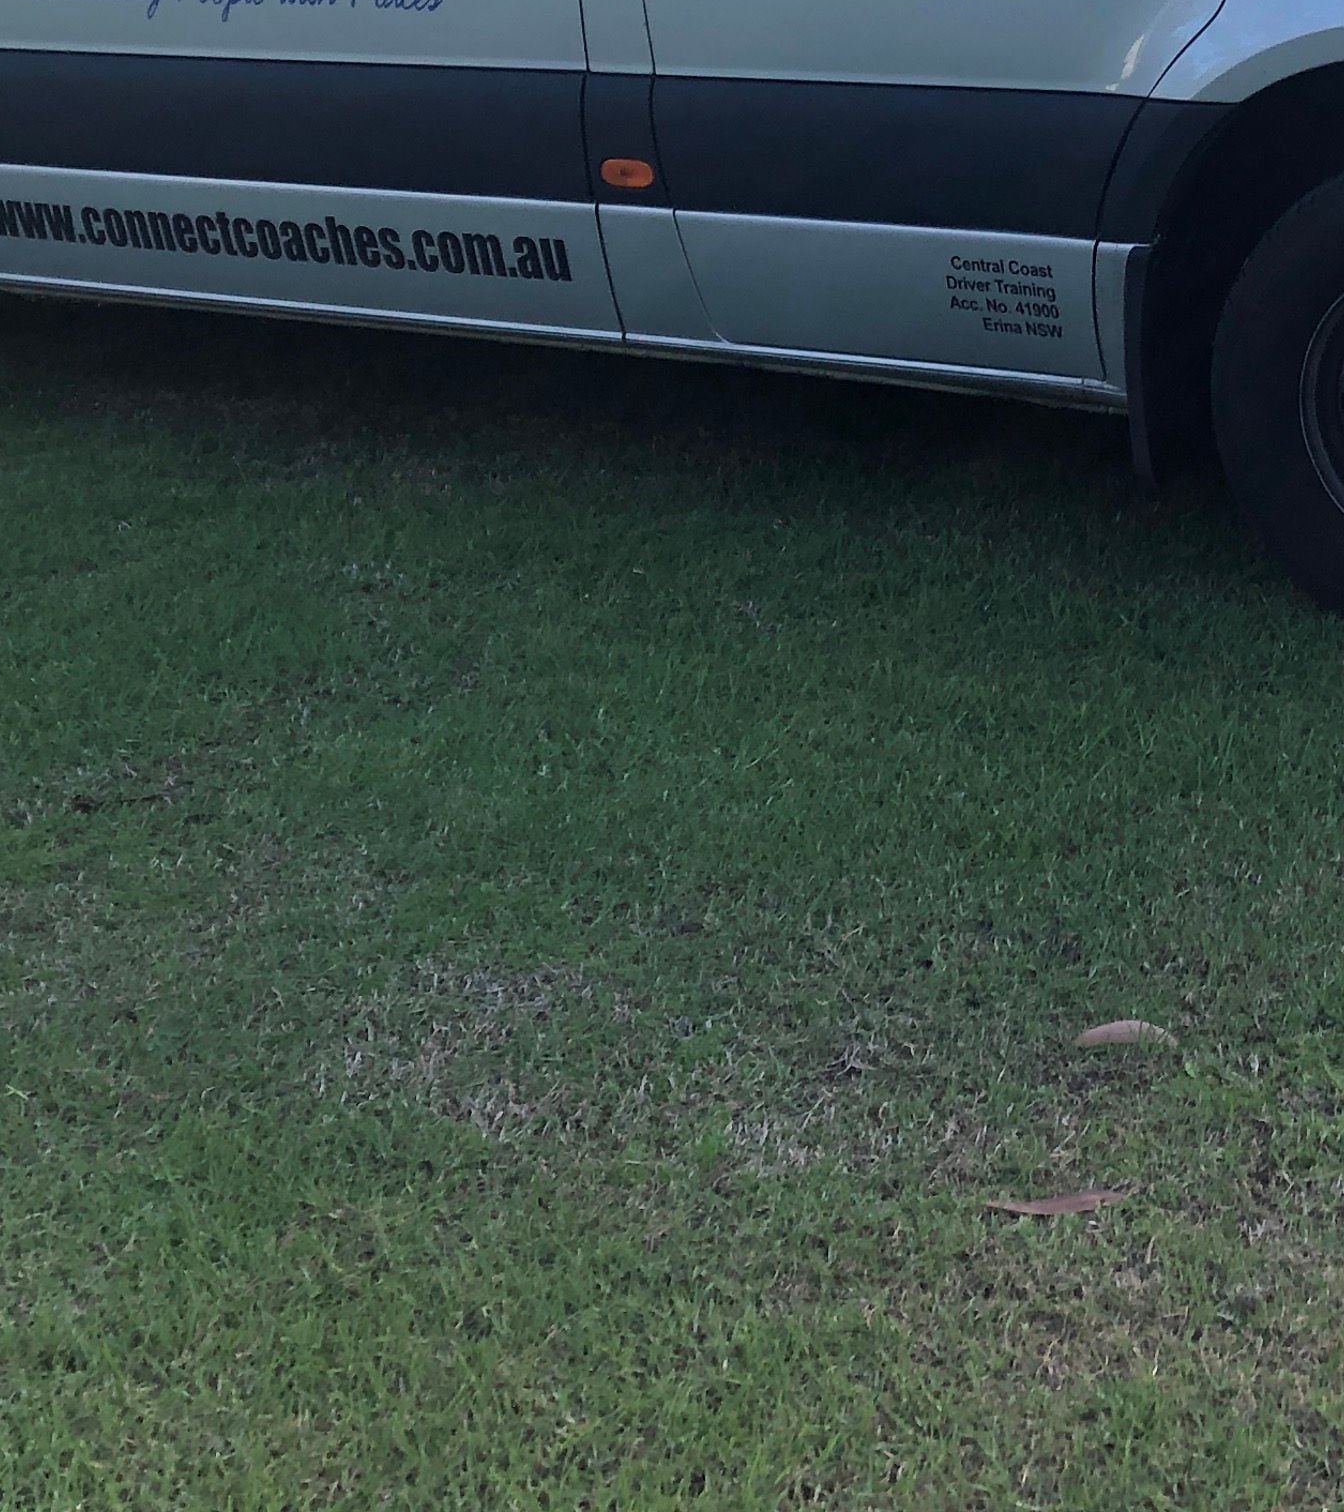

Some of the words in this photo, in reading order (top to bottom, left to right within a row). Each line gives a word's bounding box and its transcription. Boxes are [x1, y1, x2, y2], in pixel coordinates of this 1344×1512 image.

[950, 255, 1005, 275] Central
[1008, 260, 1054, 279] Coast
[946, 275, 992, 293] Driver
[995, 279, 1056, 303] Training
[950, 296, 983, 312] Acc.
[986, 298, 1012, 315] No.
[983, 317, 1023, 335] Erina
[1025, 321, 1063, 339] NSW
